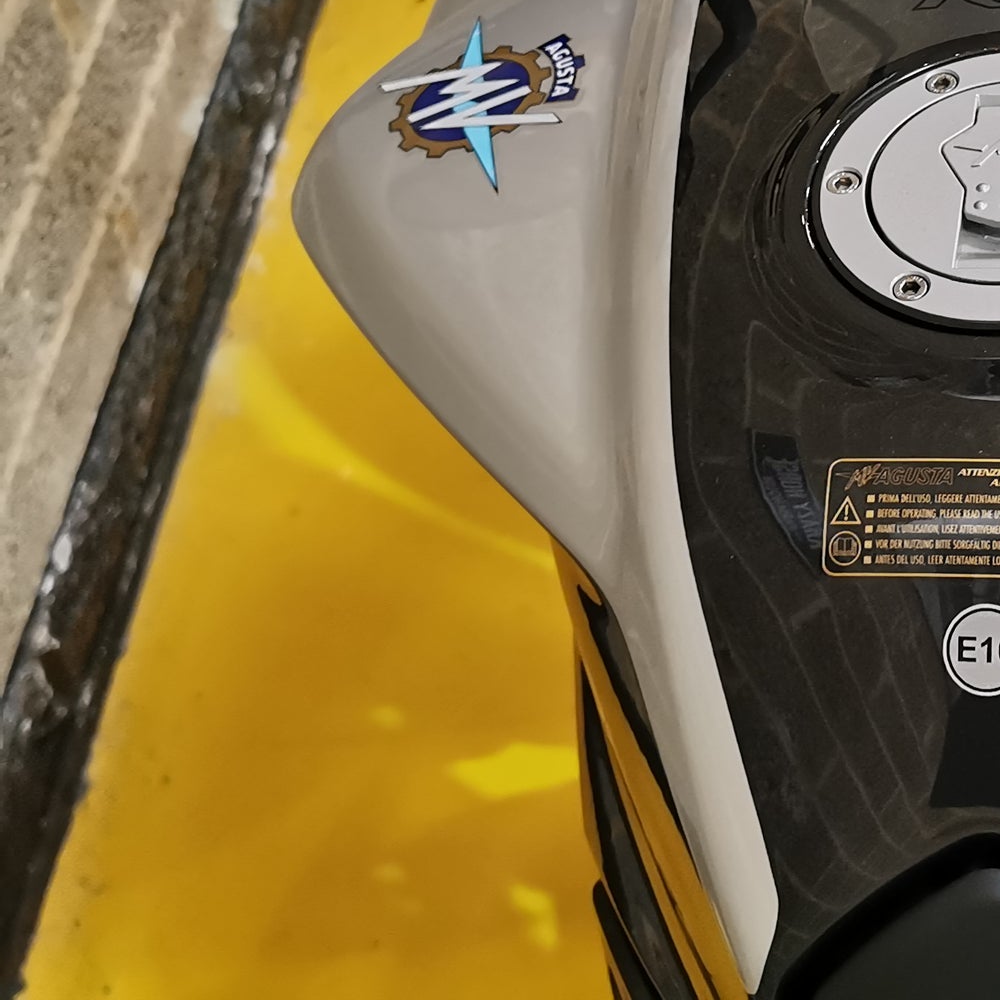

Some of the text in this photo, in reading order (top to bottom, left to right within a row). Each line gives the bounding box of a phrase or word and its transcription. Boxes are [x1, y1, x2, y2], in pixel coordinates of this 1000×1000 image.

[544, 41, 572, 98] AGUSTA
[873, 466, 954, 486] AGUSTA
[878, 494, 899, 503] PRIMA
[935, 495, 963, 503] LEGGERE
[877, 509, 900, 518] BEFORE
[940, 509, 961, 518] PLEASE
[962, 510, 980, 518] READ
[981, 510, 993, 519] THE
[876, 524, 896, 533] AVANT
[942, 525, 958, 534] LISEZ
[876, 540, 888, 549] VOR
[890, 540, 902, 549] DER
[904, 540, 934, 549] NUTZUNG
[935, 540, 951, 549] BITTE
[875, 555, 895, 564] ANTES
[897, 555, 908, 564] DEL
[928, 555, 943, 564] LEER
[945, 556, 990, 566] ATENTAMENTE
